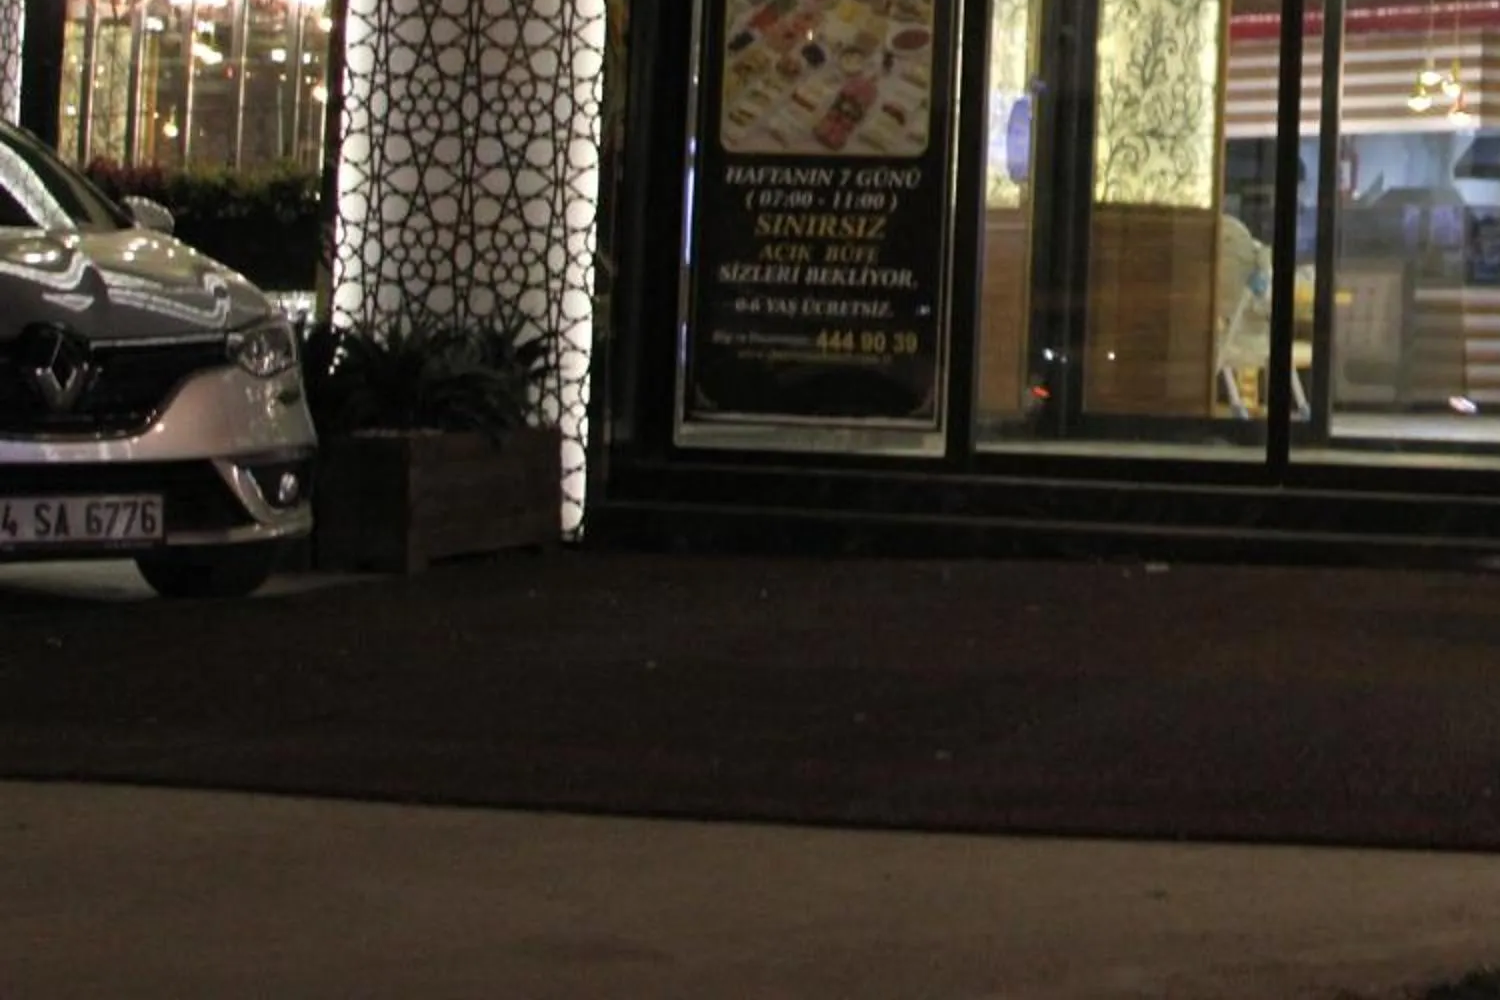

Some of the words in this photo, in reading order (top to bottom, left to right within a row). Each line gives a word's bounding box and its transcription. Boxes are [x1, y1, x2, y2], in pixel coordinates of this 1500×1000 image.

[725, 166, 834, 186] HAFTANIN
[855, 166, 922, 189] GÜNÜ
[755, 213, 887, 238] SINIRSIZ
[816, 330, 854, 352] 444
[34, 502, 69, 536] SA
[86, 501, 157, 536] 6776
